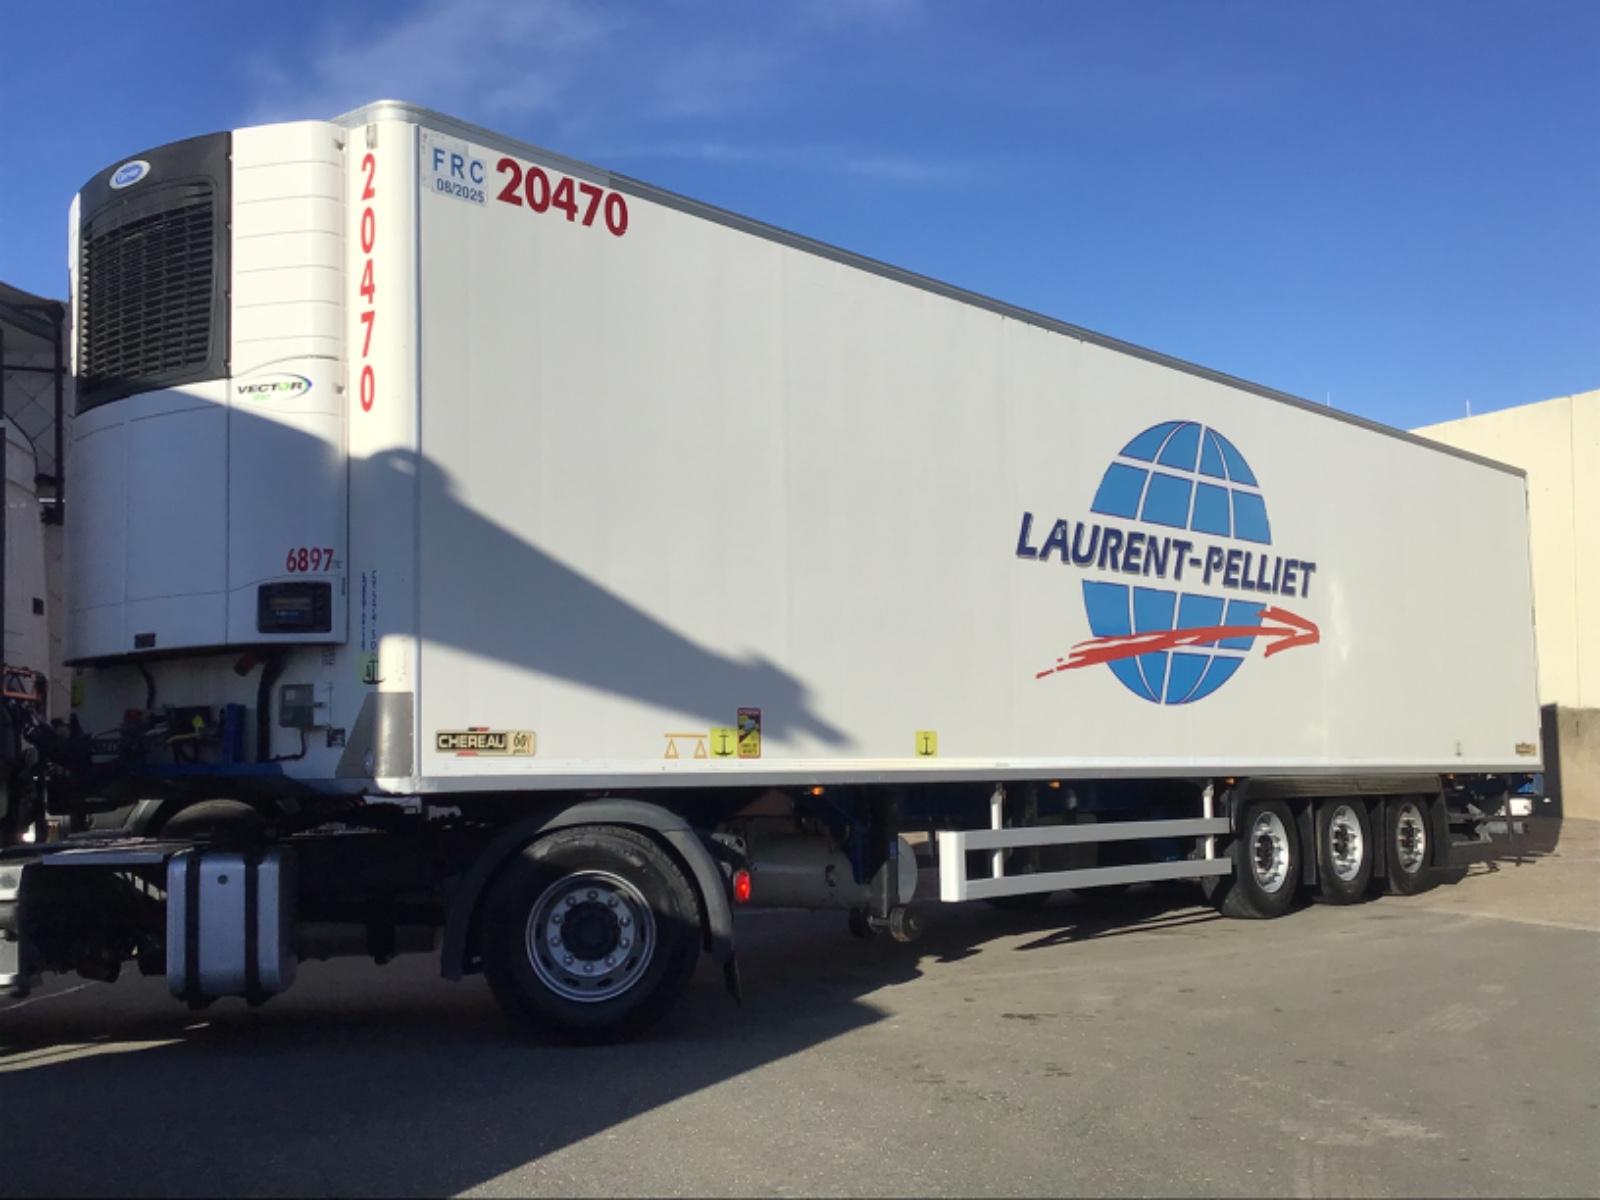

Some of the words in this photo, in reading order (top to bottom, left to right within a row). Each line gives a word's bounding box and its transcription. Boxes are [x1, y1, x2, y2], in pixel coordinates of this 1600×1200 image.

[432, 147, 484, 185] FRC
[436, 178, 485, 203] 08/2025
[495, 157, 629, 237] 20470
[360, 152, 376, 412] 20470
[237, 381, 304, 395] VECTOR
[286, 547, 335, 573] 6897
[1016, 511, 1317, 599] LAURENT-PELLIET
[438, 734, 507, 749] CHEREAU
